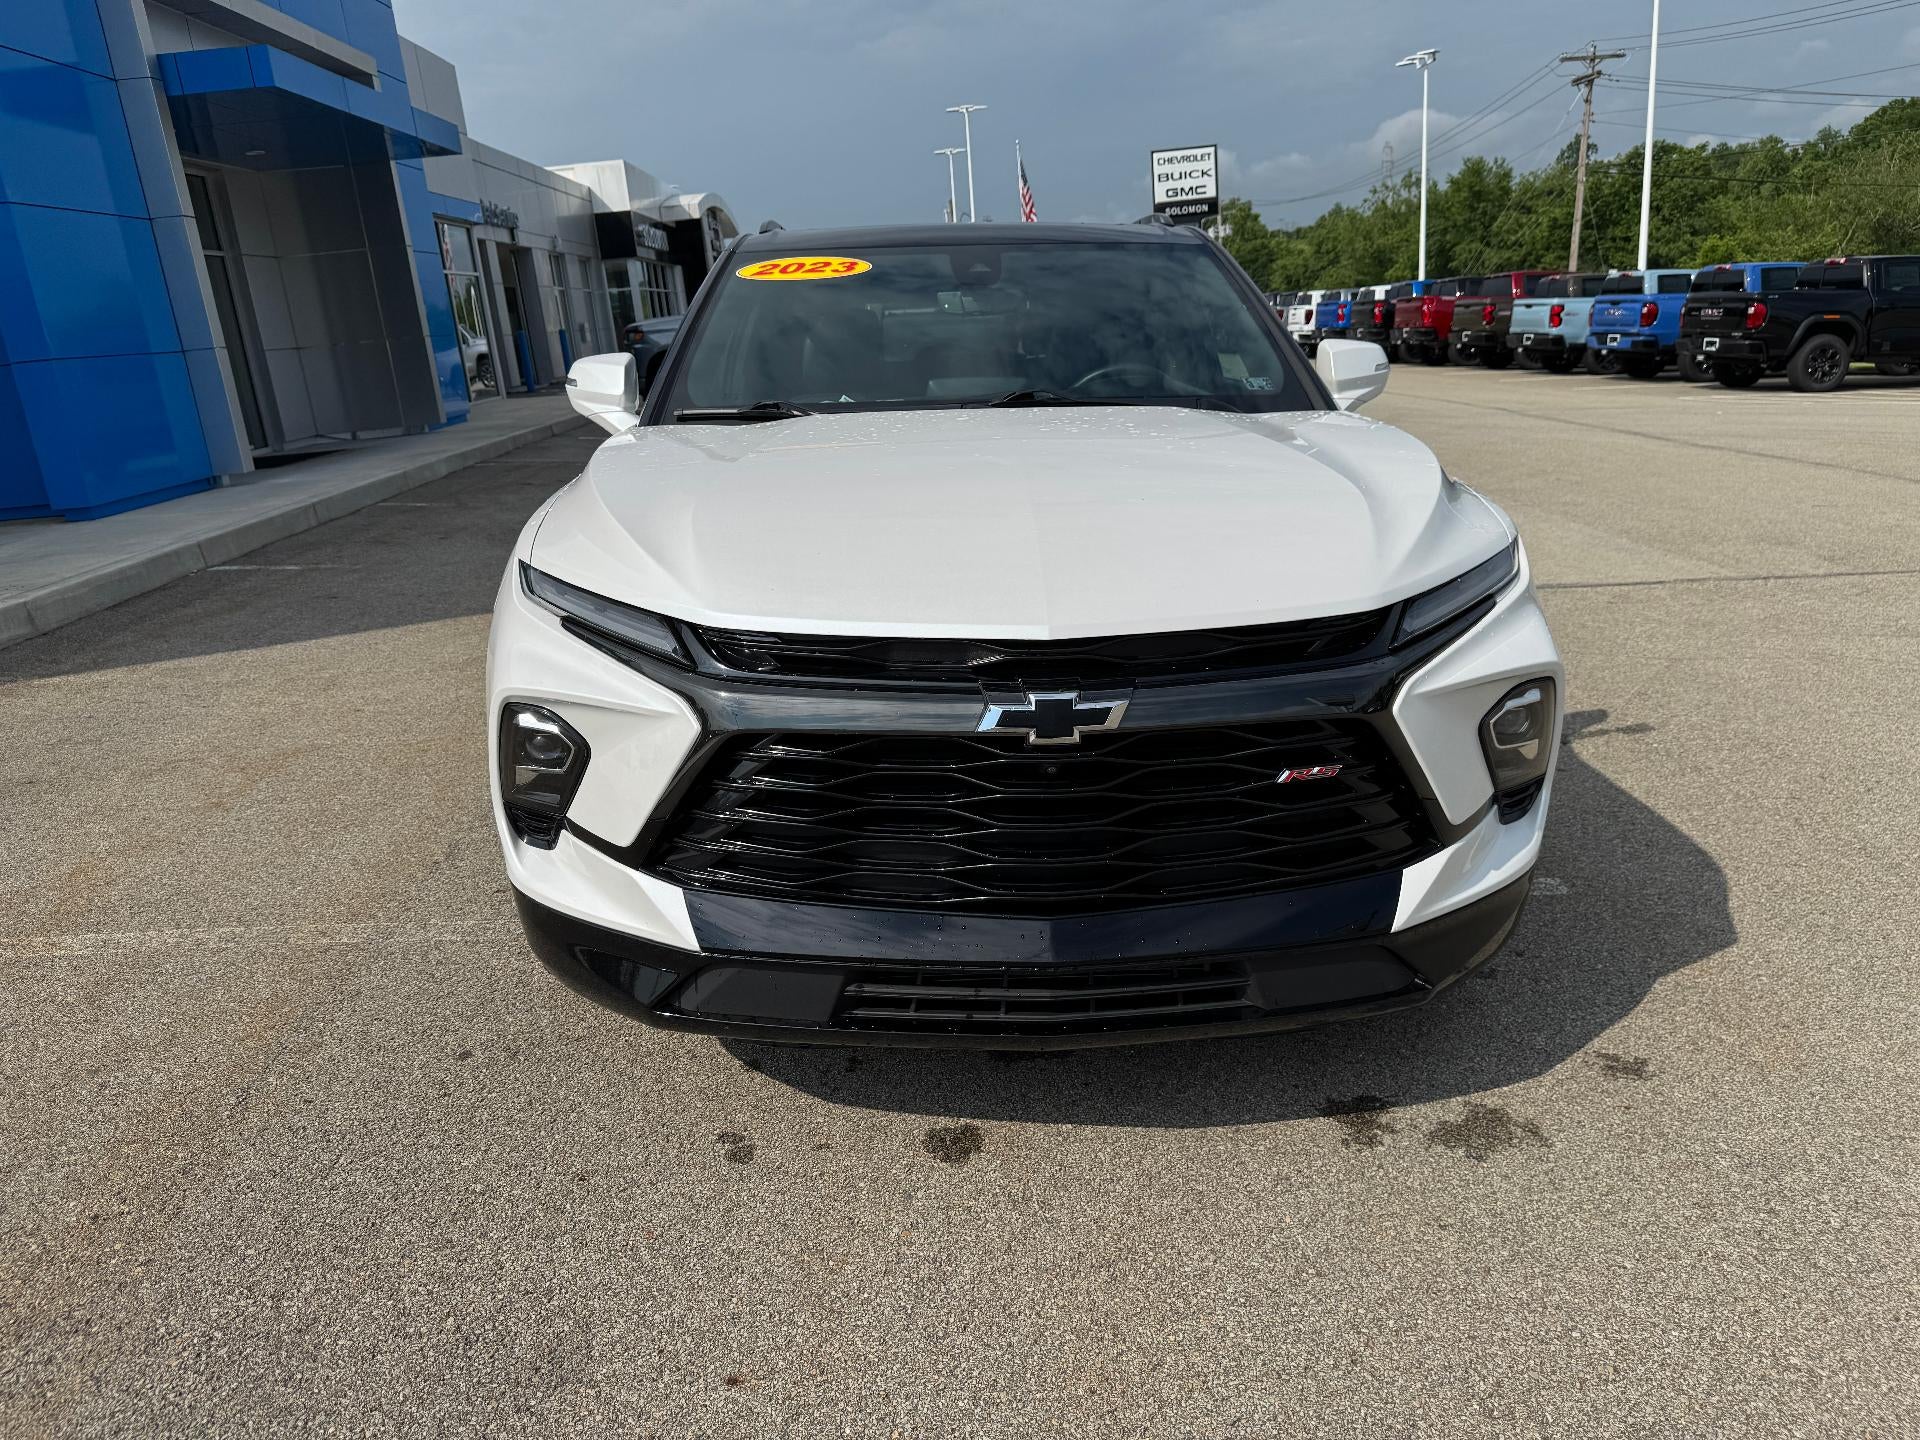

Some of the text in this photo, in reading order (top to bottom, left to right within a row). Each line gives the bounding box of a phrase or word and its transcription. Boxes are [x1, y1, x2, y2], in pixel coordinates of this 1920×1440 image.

[1157, 152, 1212, 166] CHEVROLET
[1158, 168, 1213, 183] BUICK
[1166, 185, 1207, 198] GMC
[1165, 203, 1209, 216] SOLOMON
[750, 261, 859, 276] 2023
[1277, 765, 1342, 783] RS
